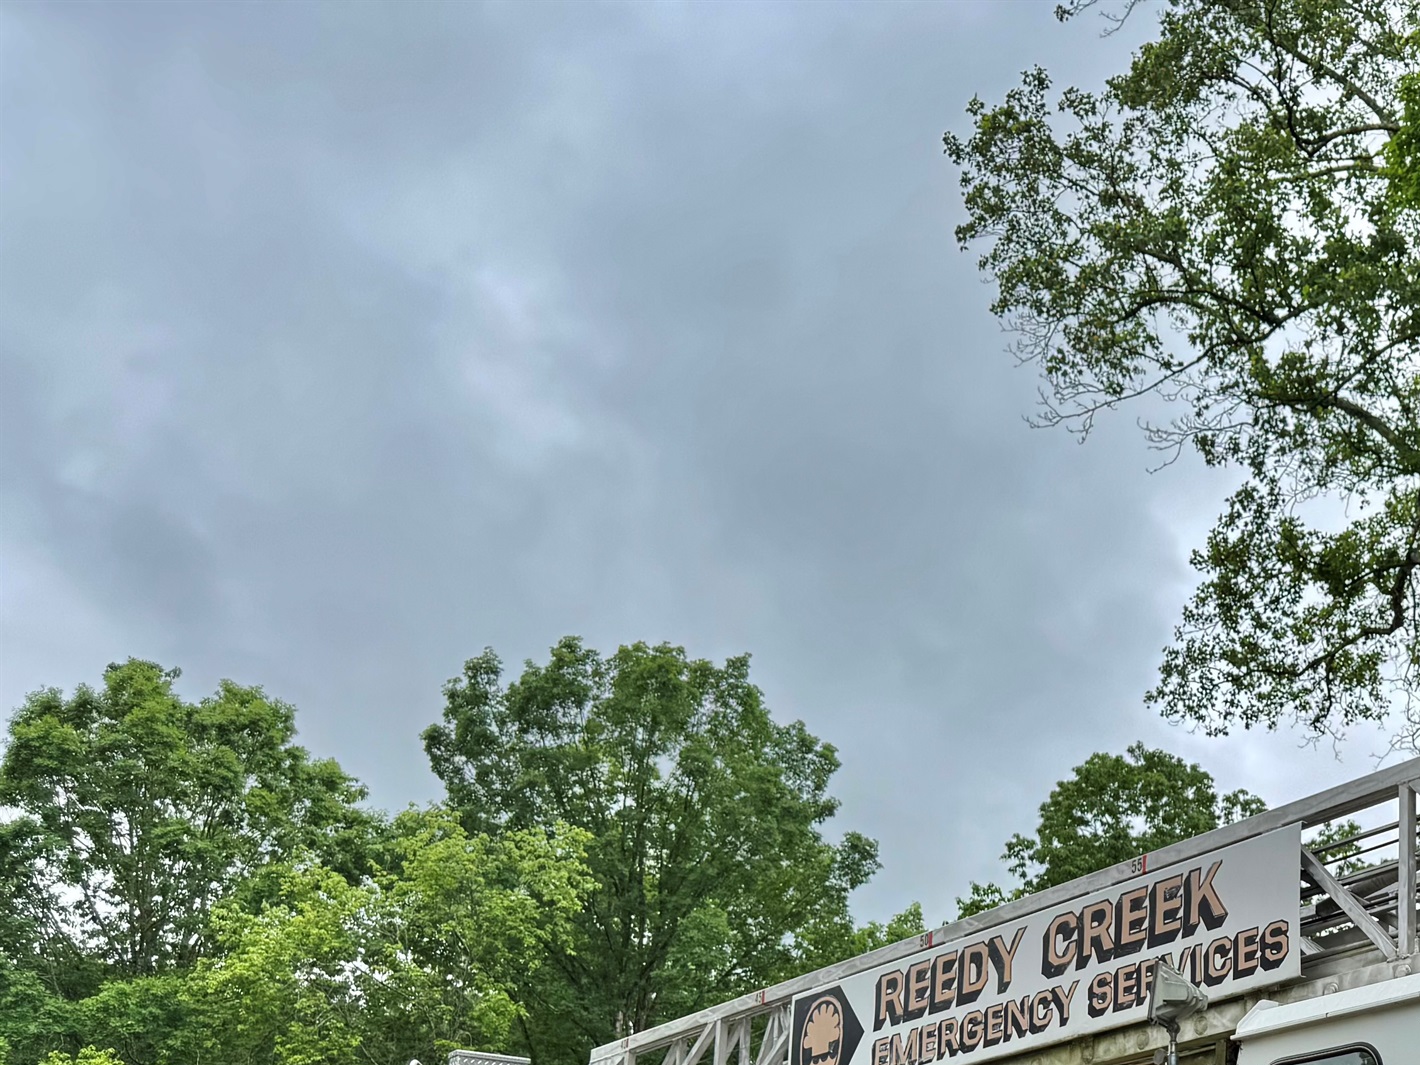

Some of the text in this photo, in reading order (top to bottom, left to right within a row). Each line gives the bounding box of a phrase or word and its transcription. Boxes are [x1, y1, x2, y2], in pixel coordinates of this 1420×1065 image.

[1131, 857, 1143, 874] 55
[873, 859, 1229, 1032] REEDY CREEK
[919, 935, 930, 948] 50
